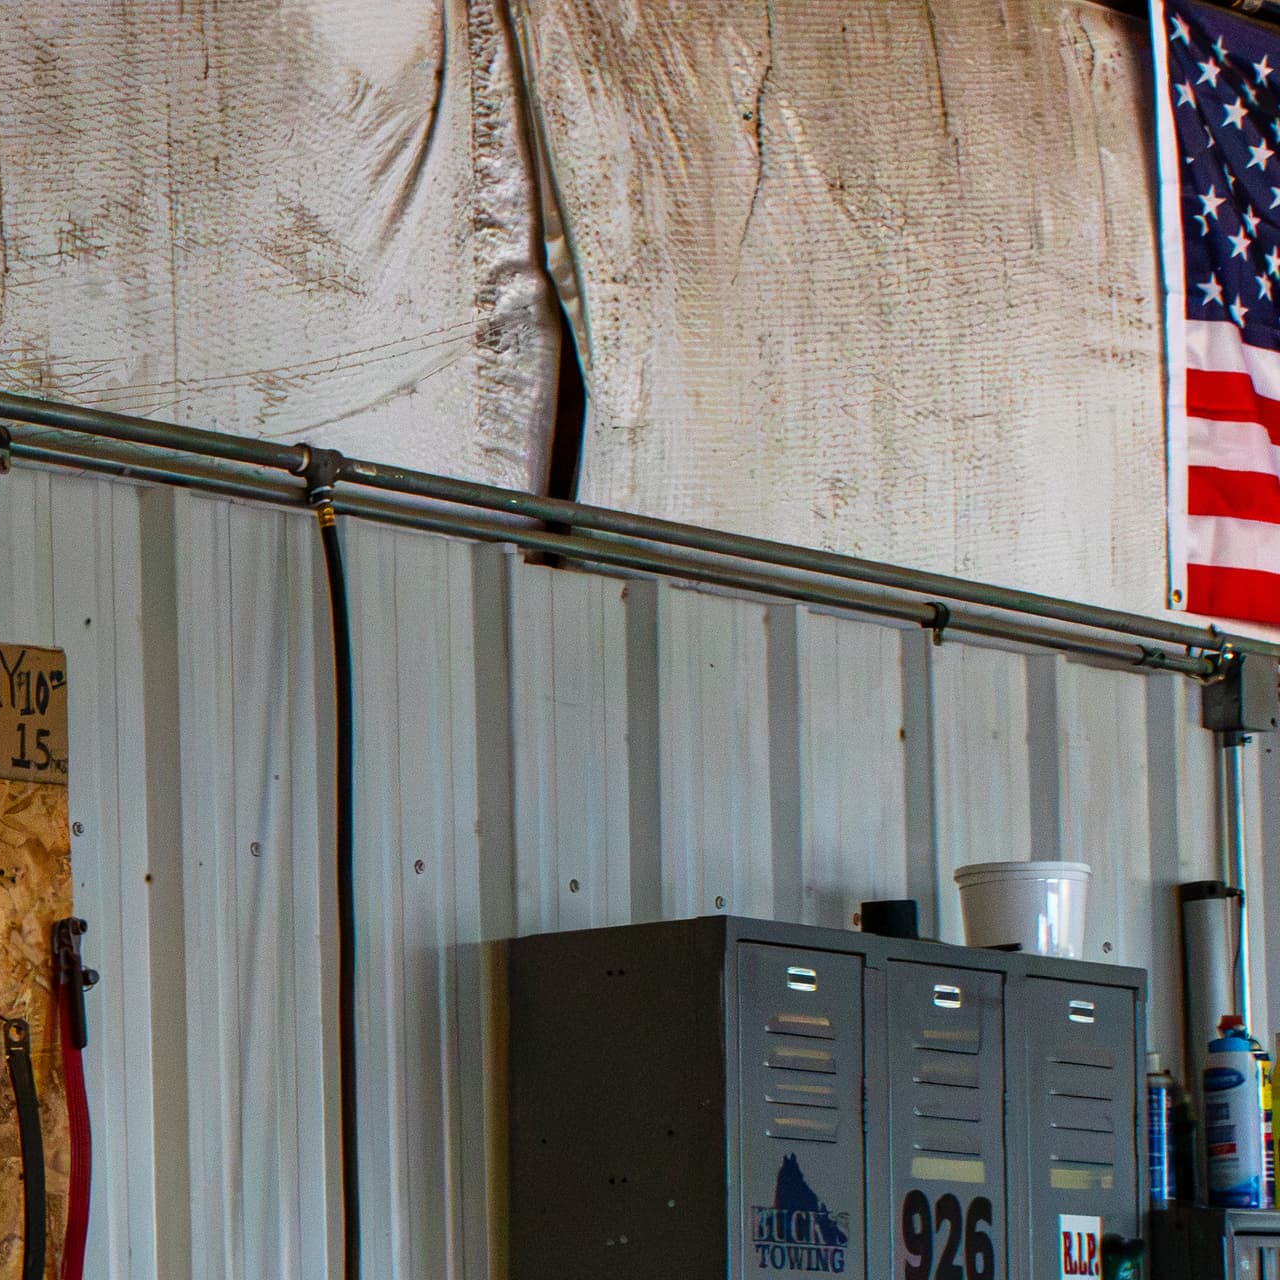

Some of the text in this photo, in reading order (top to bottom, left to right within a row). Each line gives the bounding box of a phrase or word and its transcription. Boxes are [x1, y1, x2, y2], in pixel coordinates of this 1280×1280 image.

[12, 723, 51, 770] 15
[755, 1244, 845, 1274] TOWING
[1062, 1230, 1100, 1276] R.I.P.
